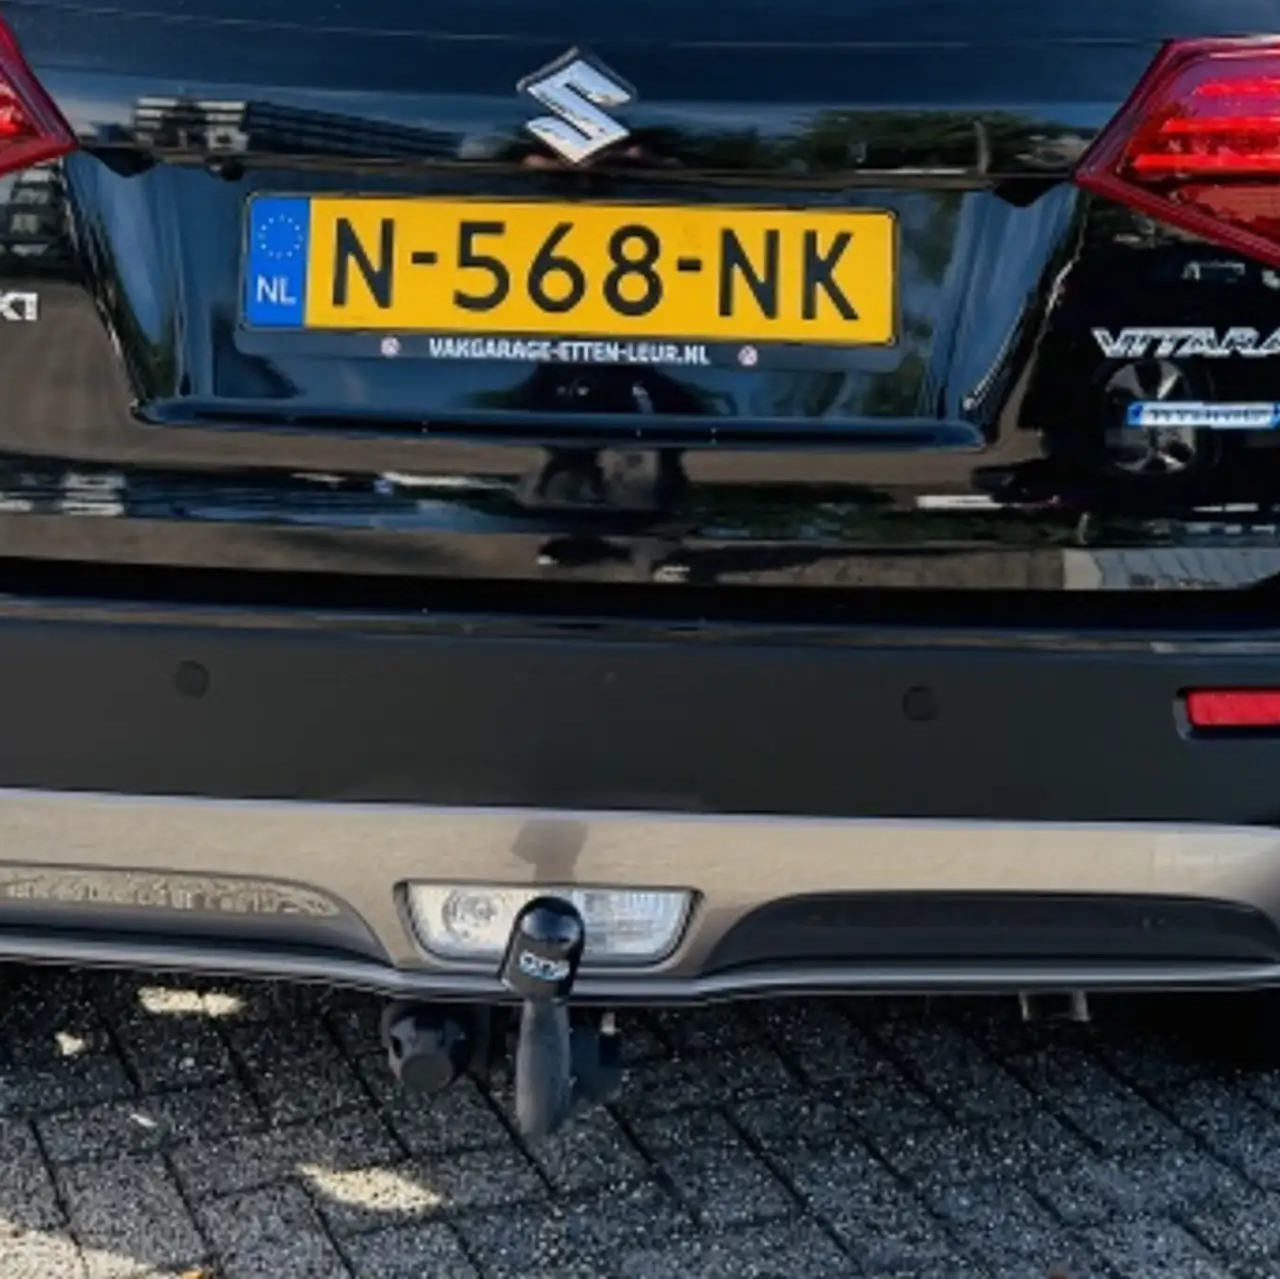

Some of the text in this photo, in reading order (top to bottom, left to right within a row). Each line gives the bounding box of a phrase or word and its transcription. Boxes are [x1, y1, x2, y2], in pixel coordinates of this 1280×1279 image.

[331, 217, 859, 321] N-568-NK
[256, 274, 298, 305] NL
[429, 337, 710, 365] VAKGARAGE-ETTEN-LEUR.NL
